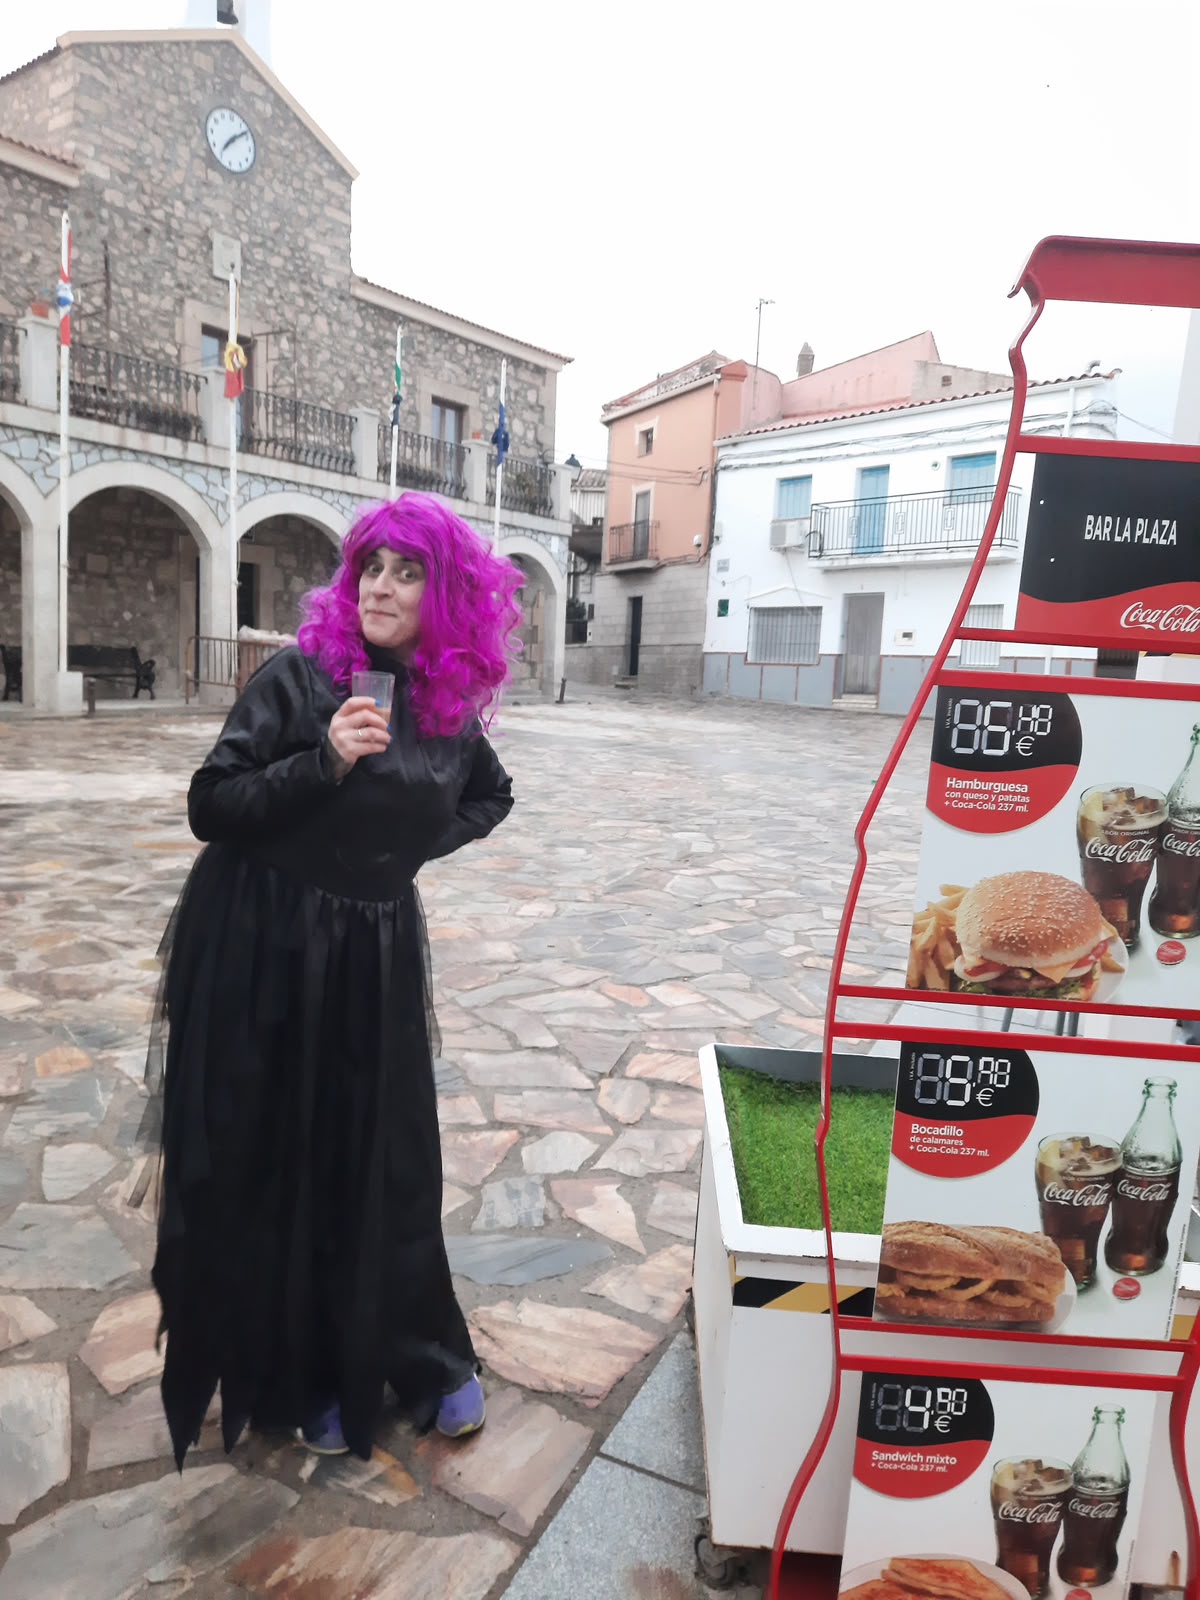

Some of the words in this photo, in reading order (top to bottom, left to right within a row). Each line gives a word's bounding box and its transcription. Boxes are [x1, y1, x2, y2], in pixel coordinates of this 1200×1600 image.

[1084, 514, 1112, 541] BAR
[1114, 517, 1131, 542] LA
[1134, 518, 1177, 545] PLAZA
[1120, 601, 1200, 632] Coca-Cola
[946, 777, 1029, 793] Hamburguesa
[962, 792, 989, 800] queso
[991, 794, 997, 802] y
[998, 794, 1030, 803] patatas
[951, 800, 996, 810] Coca-Cola
[997, 803, 1014, 811] 237
[1015, 804, 1029, 812] ml.
[1085, 837, 1157, 863] Coca-Cola
[911, 1123, 964, 1137] Bocadillo
[910, 1135, 921, 1143] de
[922, 1136, 964, 1146] calamares
[916, 1144, 959, 1155] Coca-Cola
[960, 1147, 976, 1155] 237
[1043, 1182, 1112, 1206] Coca-Cola
[1117, 1179, 1171, 1201] Coca-Cola
[872, 1450, 924, 1463] Sandwich
[926, 1454, 958, 1465] mixto
[877, 1461, 918, 1471] Coca-Cola
[919, 1464, 935, 1472] 237
[999, 1501, 1063, 1523] Coca-Cola
[1068, 1498, 1120, 1519] Coca-Cola
